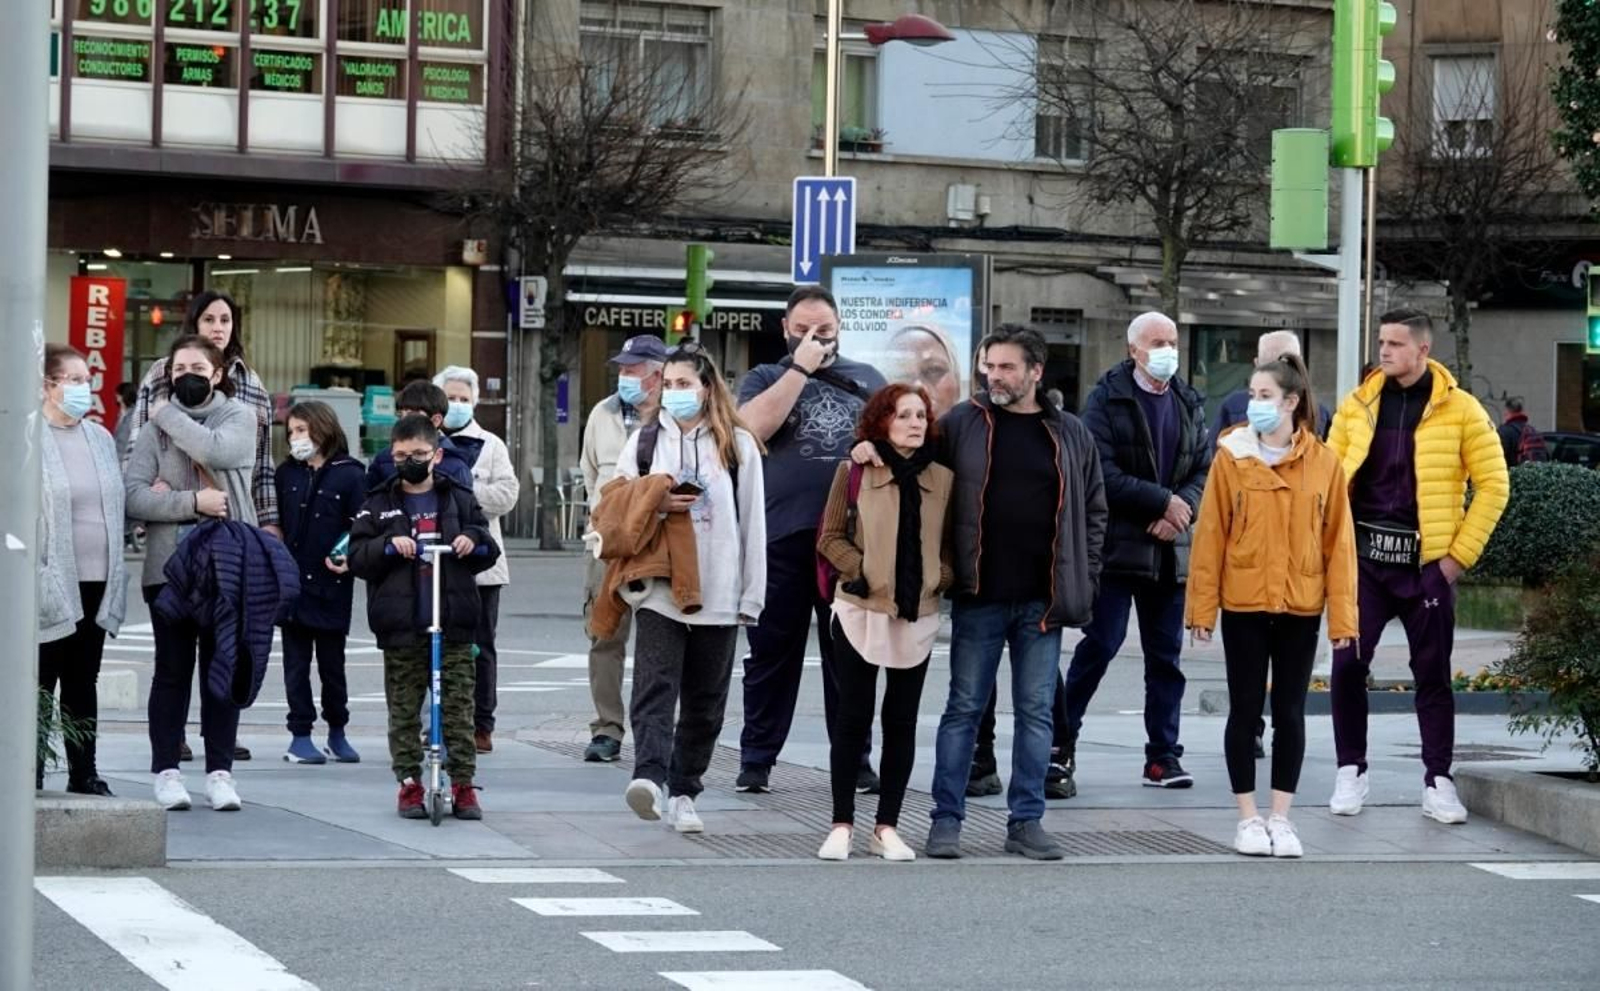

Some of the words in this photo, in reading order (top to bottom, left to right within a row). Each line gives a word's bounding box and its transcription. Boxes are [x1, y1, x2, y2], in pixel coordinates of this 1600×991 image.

[169, 0, 228, 25] 212
[376, 8, 471, 43] AMRICA
[74, 40, 149, 58] RECONOCIMIENTO
[176, 47, 220, 64] PERMISOS
[79, 59, 144, 77] CONDUCTORES
[253, 53, 313, 70] CERTIFICADOS
[182, 66, 213, 82] ARMAS
[190, 202, 325, 244] SELMA
[840, 297, 883, 308] NUESTRA
[885, 298, 947, 308] INDIFERENCIA
[584, 307, 666, 328] CAFETER
[703, 312, 762, 331] LIPPER
[840, 309, 858, 319] LOS
[840, 321, 851, 331] AL
[853, 322, 887, 331] OLVIDO
[1369, 549, 1412, 563] EXCHANGE
